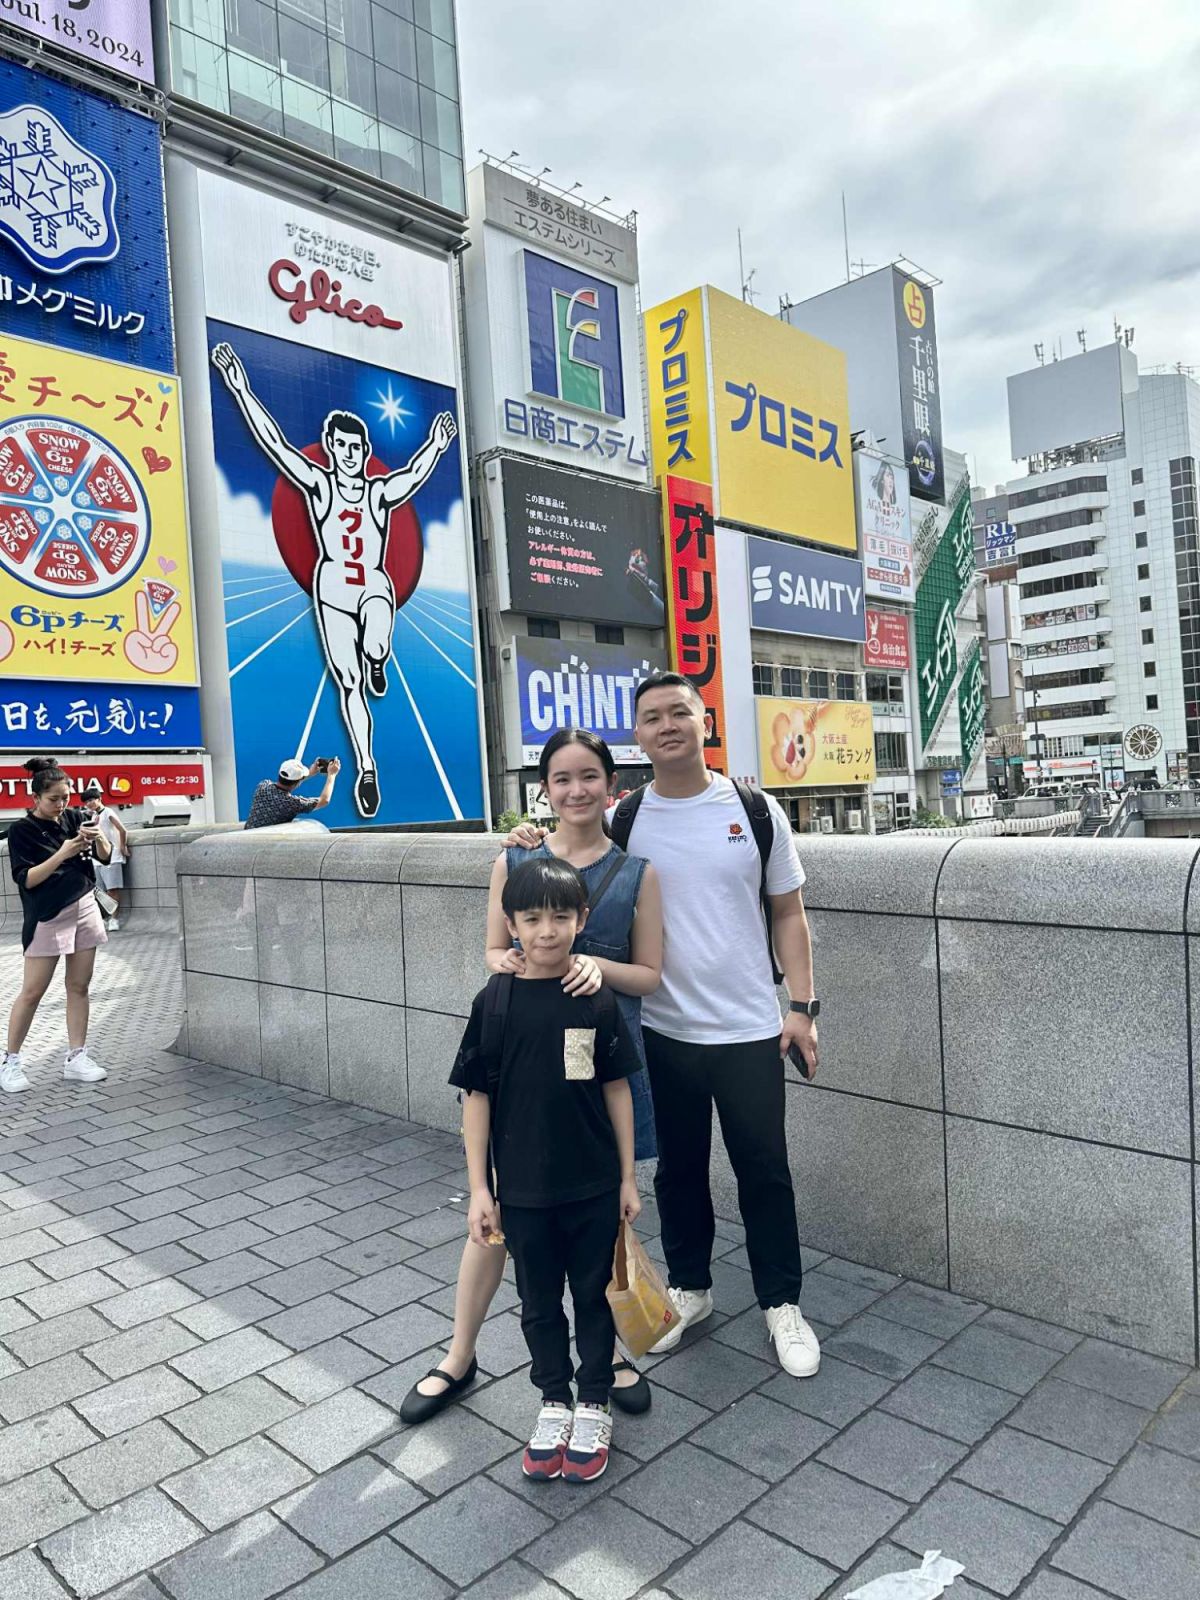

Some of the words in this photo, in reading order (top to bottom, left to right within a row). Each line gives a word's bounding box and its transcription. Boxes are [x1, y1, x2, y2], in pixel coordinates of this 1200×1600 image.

[51, 13, 82, 43] 18,
[87, 28, 144, 67] 2024
[525, 188, 603, 236] 夢ある住まい
[514, 210, 617, 268] エステムシリーズ
[268, 259, 403, 330] Glico
[907, 284, 923, 324] 占
[659, 308, 696, 468] プロミス
[38, 432, 80, 450] SNOW
[504, 398, 648, 466] 日商エステム
[725, 380, 844, 469] プロミス
[47, 464, 74, 474] CHEESE
[103, 465, 133, 504] SNOW
[0, 520, 20, 553] SNO
[110, 530, 134, 568] SNOW
[337, 506, 366, 587] グリコ
[45, 566, 87, 581] SNOW
[778, 570, 862, 616] SAMTY
